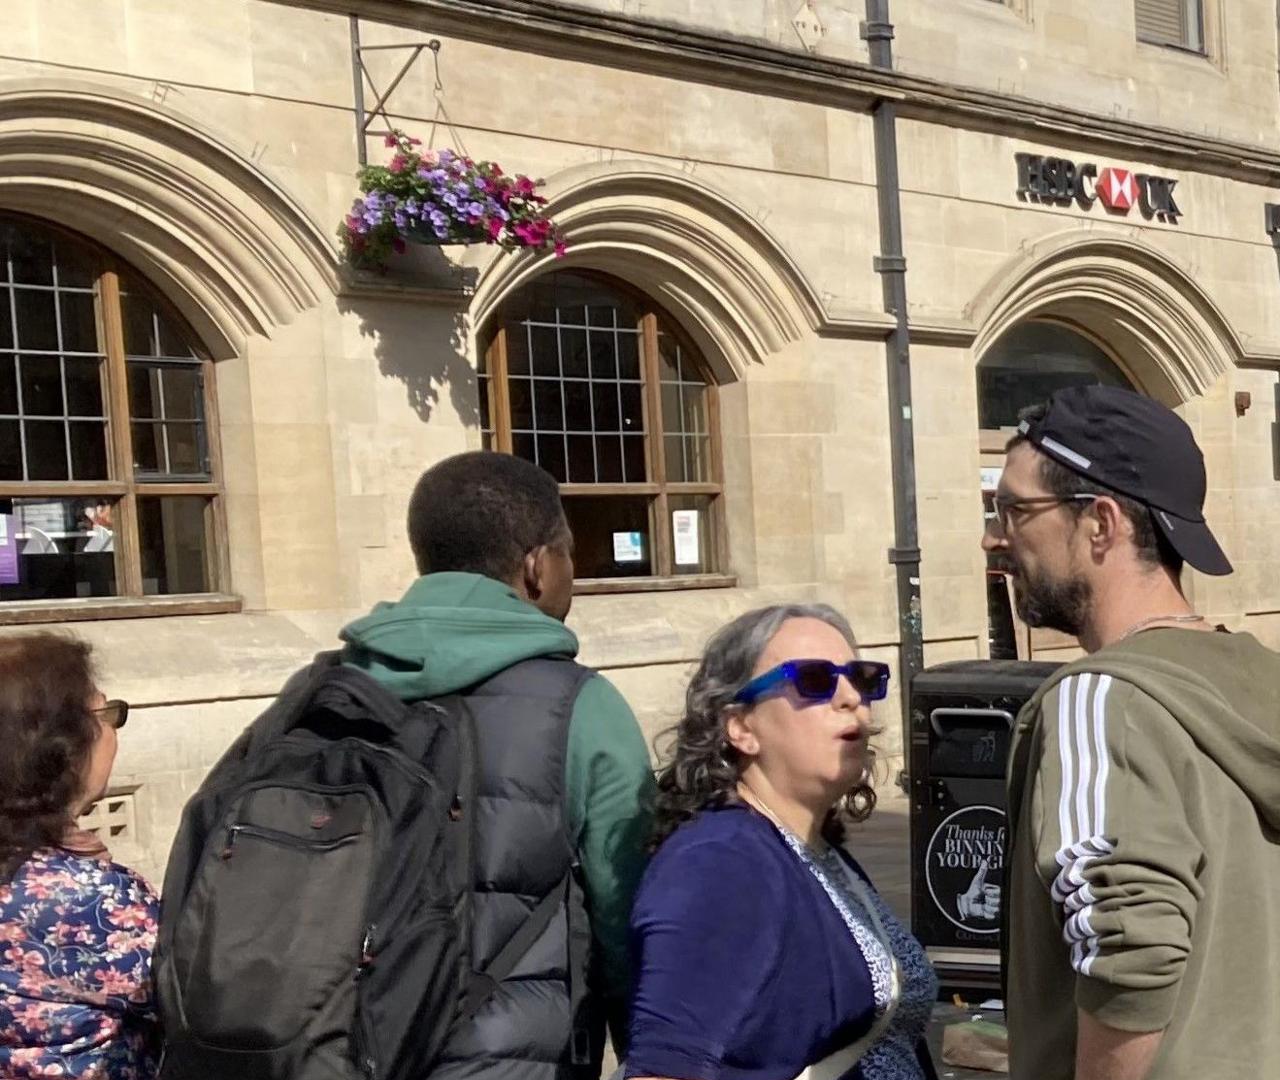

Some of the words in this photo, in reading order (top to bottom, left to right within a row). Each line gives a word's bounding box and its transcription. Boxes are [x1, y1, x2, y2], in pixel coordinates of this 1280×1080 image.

[1014, 153, 1097, 206] HSBC
[1135, 173, 1182, 221] UK
[946, 824, 995, 840] Thanks
[936, 852, 982, 869] YOUR
